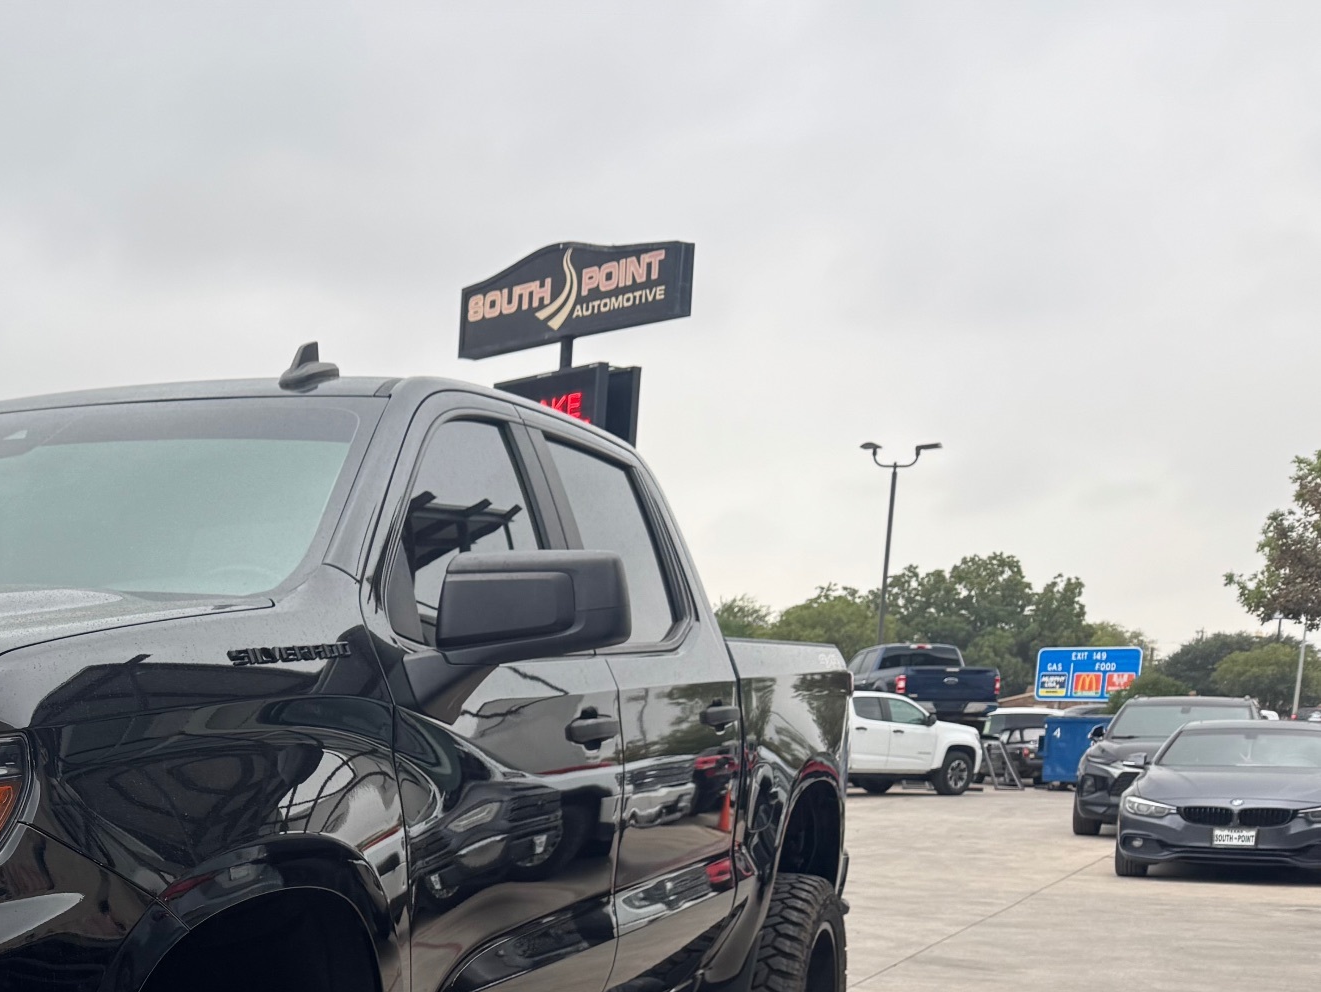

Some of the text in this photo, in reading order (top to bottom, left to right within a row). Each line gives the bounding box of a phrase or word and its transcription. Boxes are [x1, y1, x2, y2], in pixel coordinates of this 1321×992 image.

[468, 249, 665, 322] SOUTH POINT
[572, 286, 665, 319] AUTOMOTIVE
[226, 641, 351, 666] SILVERADO
[1071, 651, 1107, 660] EXIT 149
[1047, 663, 1063, 671] GAS
[1095, 662, 1116, 671] FOOD
[1053, 727, 1061, 739] 4
[1215, 834, 1255, 843] SOUTH POINT
